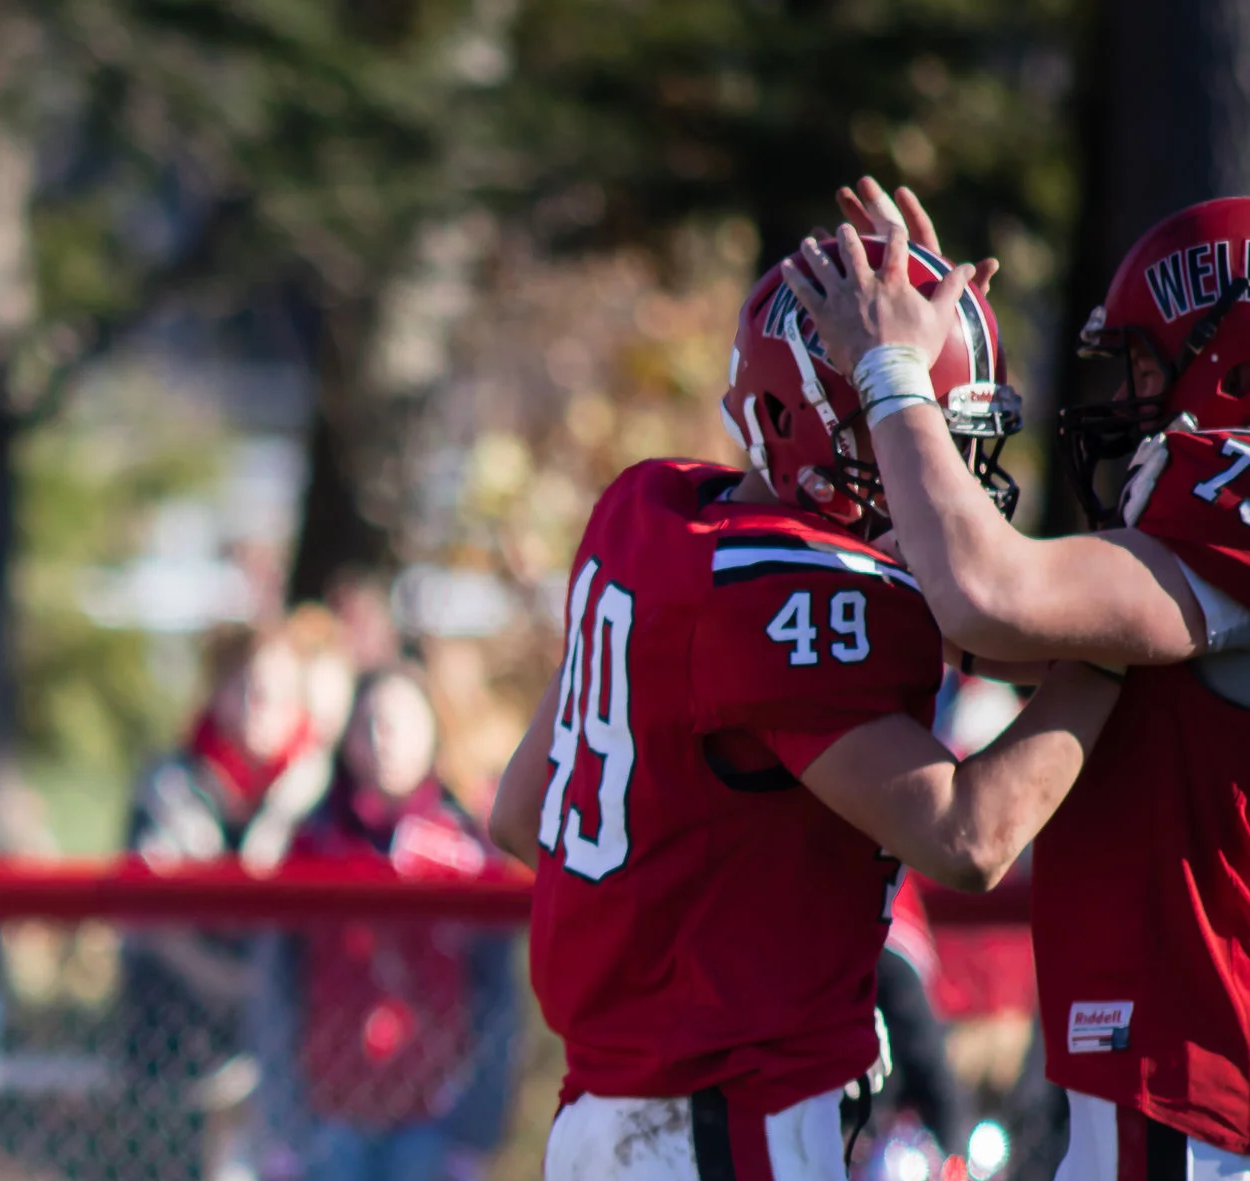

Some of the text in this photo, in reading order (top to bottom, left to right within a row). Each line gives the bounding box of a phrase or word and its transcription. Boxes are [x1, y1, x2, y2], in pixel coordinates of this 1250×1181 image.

[1145, 239, 1250, 323] WEL
[1191, 437, 1250, 526] 7
[765, 589, 871, 666] 49
[537, 553, 636, 885] 49
[1074, 1010, 1122, 1026] Riddell
